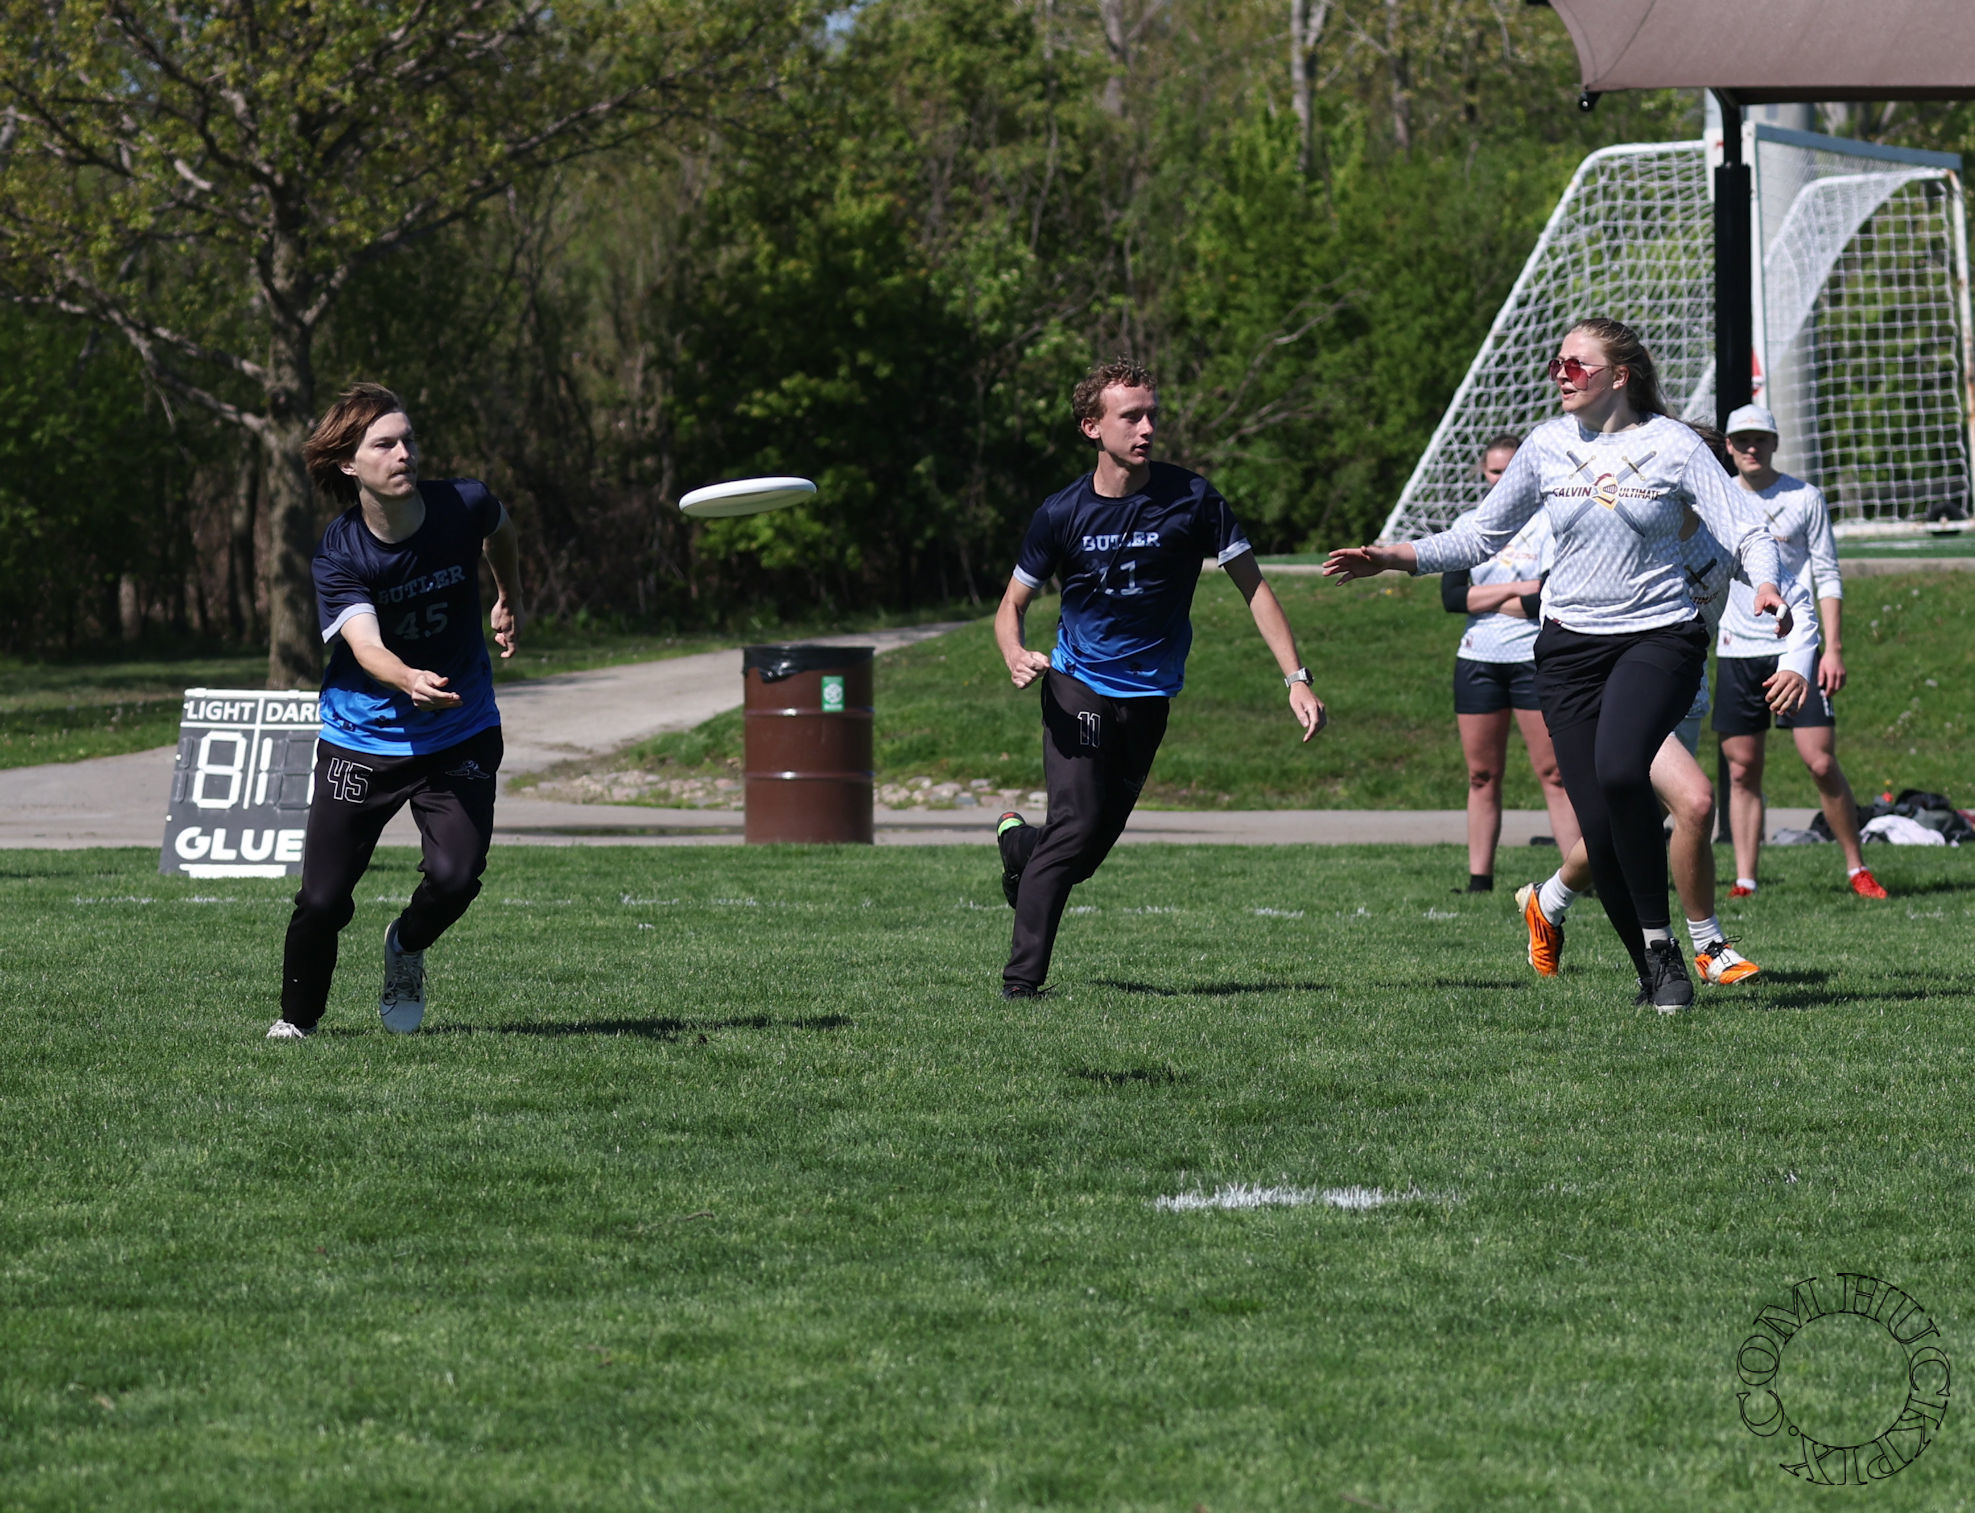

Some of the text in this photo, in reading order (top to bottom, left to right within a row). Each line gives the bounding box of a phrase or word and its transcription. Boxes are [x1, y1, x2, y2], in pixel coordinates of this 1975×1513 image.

[1552, 486, 1592, 498] CALVIN
[377, 564, 466, 604] BUTLER
[393, 602, 449, 640] 45
[186, 700, 255, 721] LIGHT
[1077, 711, 1100, 748] 11
[327, 757, 373, 803] 45
[175, 826, 306, 862] GLUE
